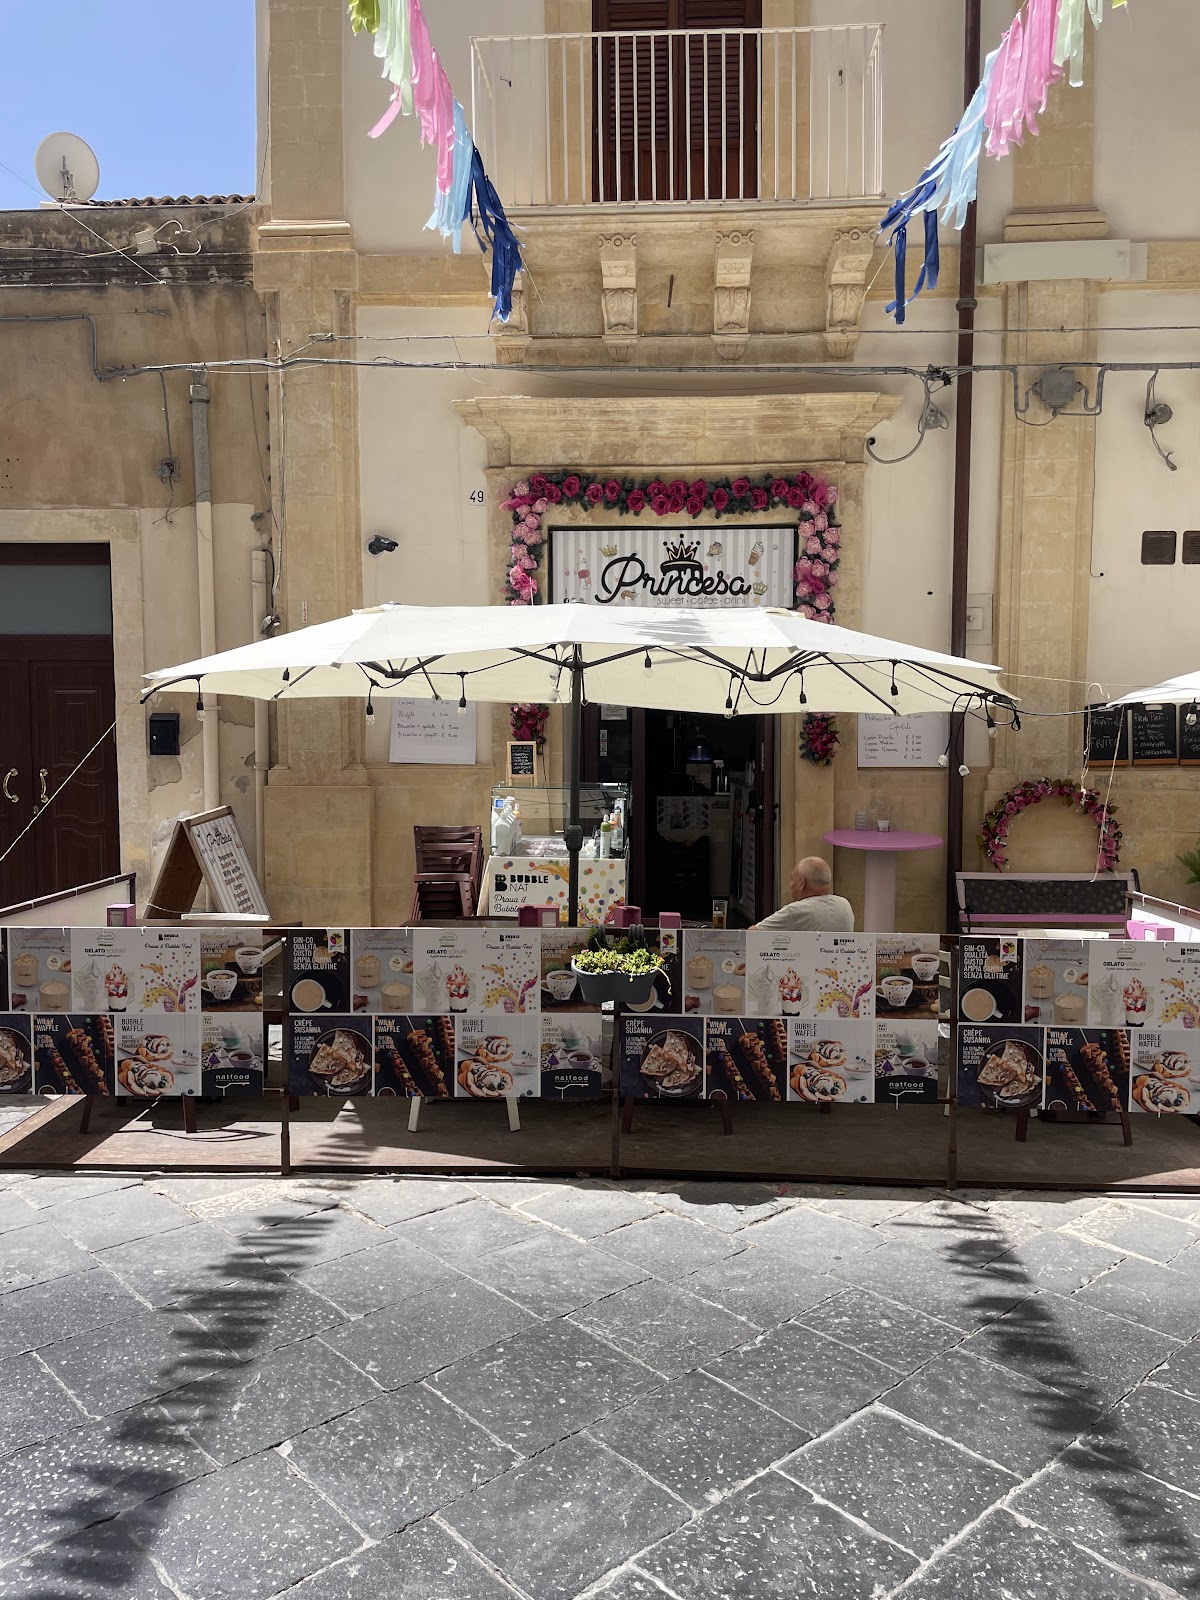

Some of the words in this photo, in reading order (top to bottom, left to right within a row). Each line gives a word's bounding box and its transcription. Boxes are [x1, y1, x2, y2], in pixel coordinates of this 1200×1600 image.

[469, 490, 484, 503] 49
[595, 553, 752, 604] Princesa
[656, 597, 685, 605] sweet
[510, 875, 549, 884] BUBBLE
[510, 884, 529, 892] NAT
